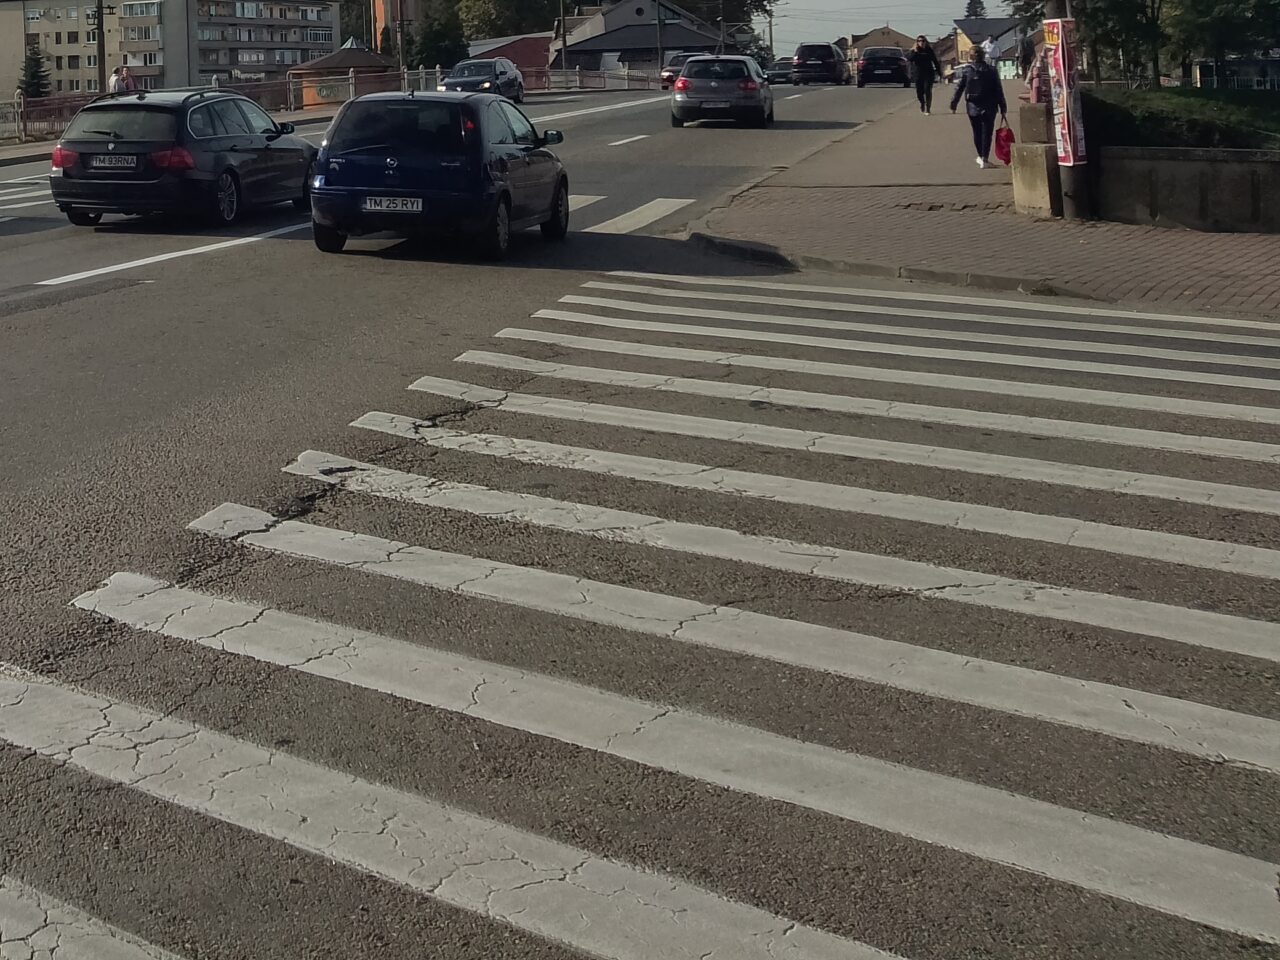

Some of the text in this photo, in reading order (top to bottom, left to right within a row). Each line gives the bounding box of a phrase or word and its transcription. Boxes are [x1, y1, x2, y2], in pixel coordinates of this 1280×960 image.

[368, 198, 419, 209] TM 25 RYI
